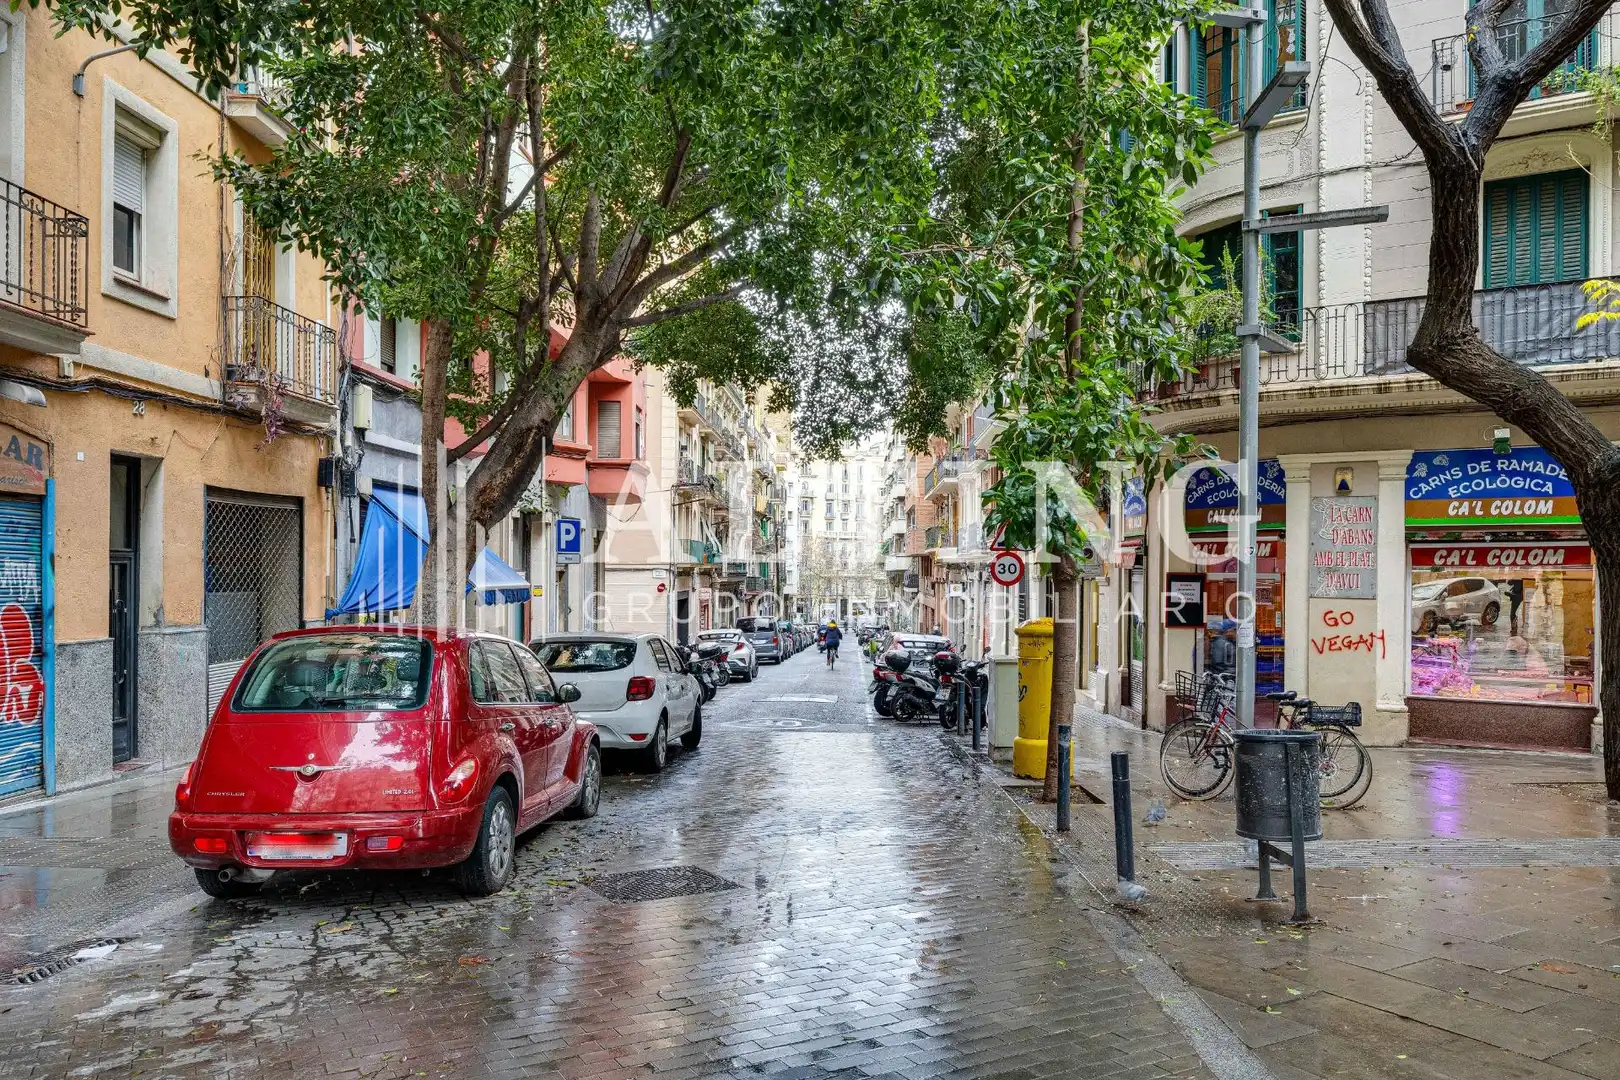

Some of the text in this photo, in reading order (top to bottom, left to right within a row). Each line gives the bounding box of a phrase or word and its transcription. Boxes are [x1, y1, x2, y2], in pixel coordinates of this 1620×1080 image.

[133, 400, 145, 415] 28
[0, 434, 43, 471] AR
[1409, 459, 1570, 499] CARNS DE RAMADE
[1448, 474, 1553, 499] ECOLÒGICA
[1187, 479, 1215, 504] CARNS
[1330, 506, 1373, 524] LA CARN
[1448, 499, 1554, 516] CA'L COLOM
[560, 522, 576, 549] P
[1332, 529, 1374, 546] D'ABANS
[1313, 551, 1333, 568] AMB
[1336, 551, 1347, 568] EL
[1433, 549, 1566, 565] CA'L COLOM
[997, 563, 1017, 575] 30
[1323, 610, 1354, 627] GO
[1311, 629, 1386, 659] VEGAN
